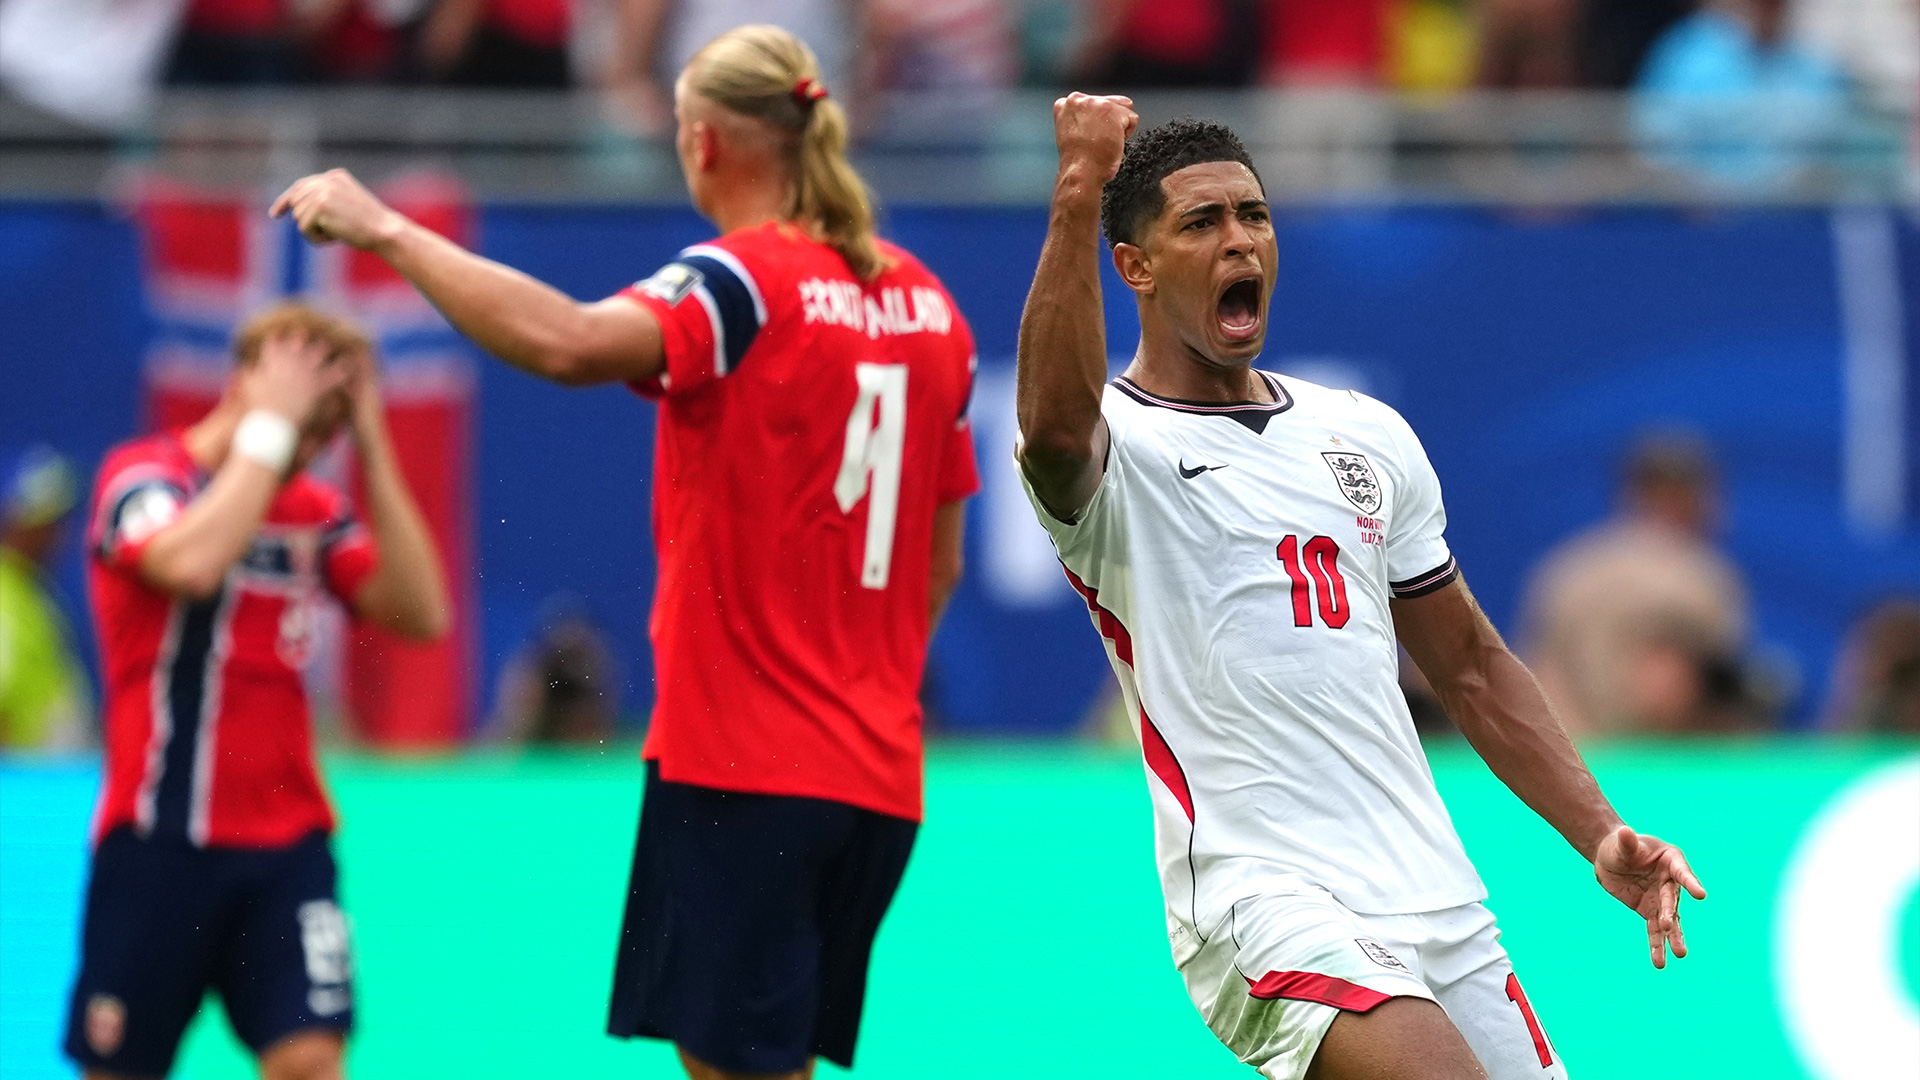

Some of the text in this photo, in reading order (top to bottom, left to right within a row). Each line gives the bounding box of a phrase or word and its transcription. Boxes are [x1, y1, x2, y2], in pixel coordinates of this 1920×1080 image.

[1357, 516, 1383, 530] NORW
[1276, 534, 1350, 629] 10
[1505, 972, 1556, 1069] 1
